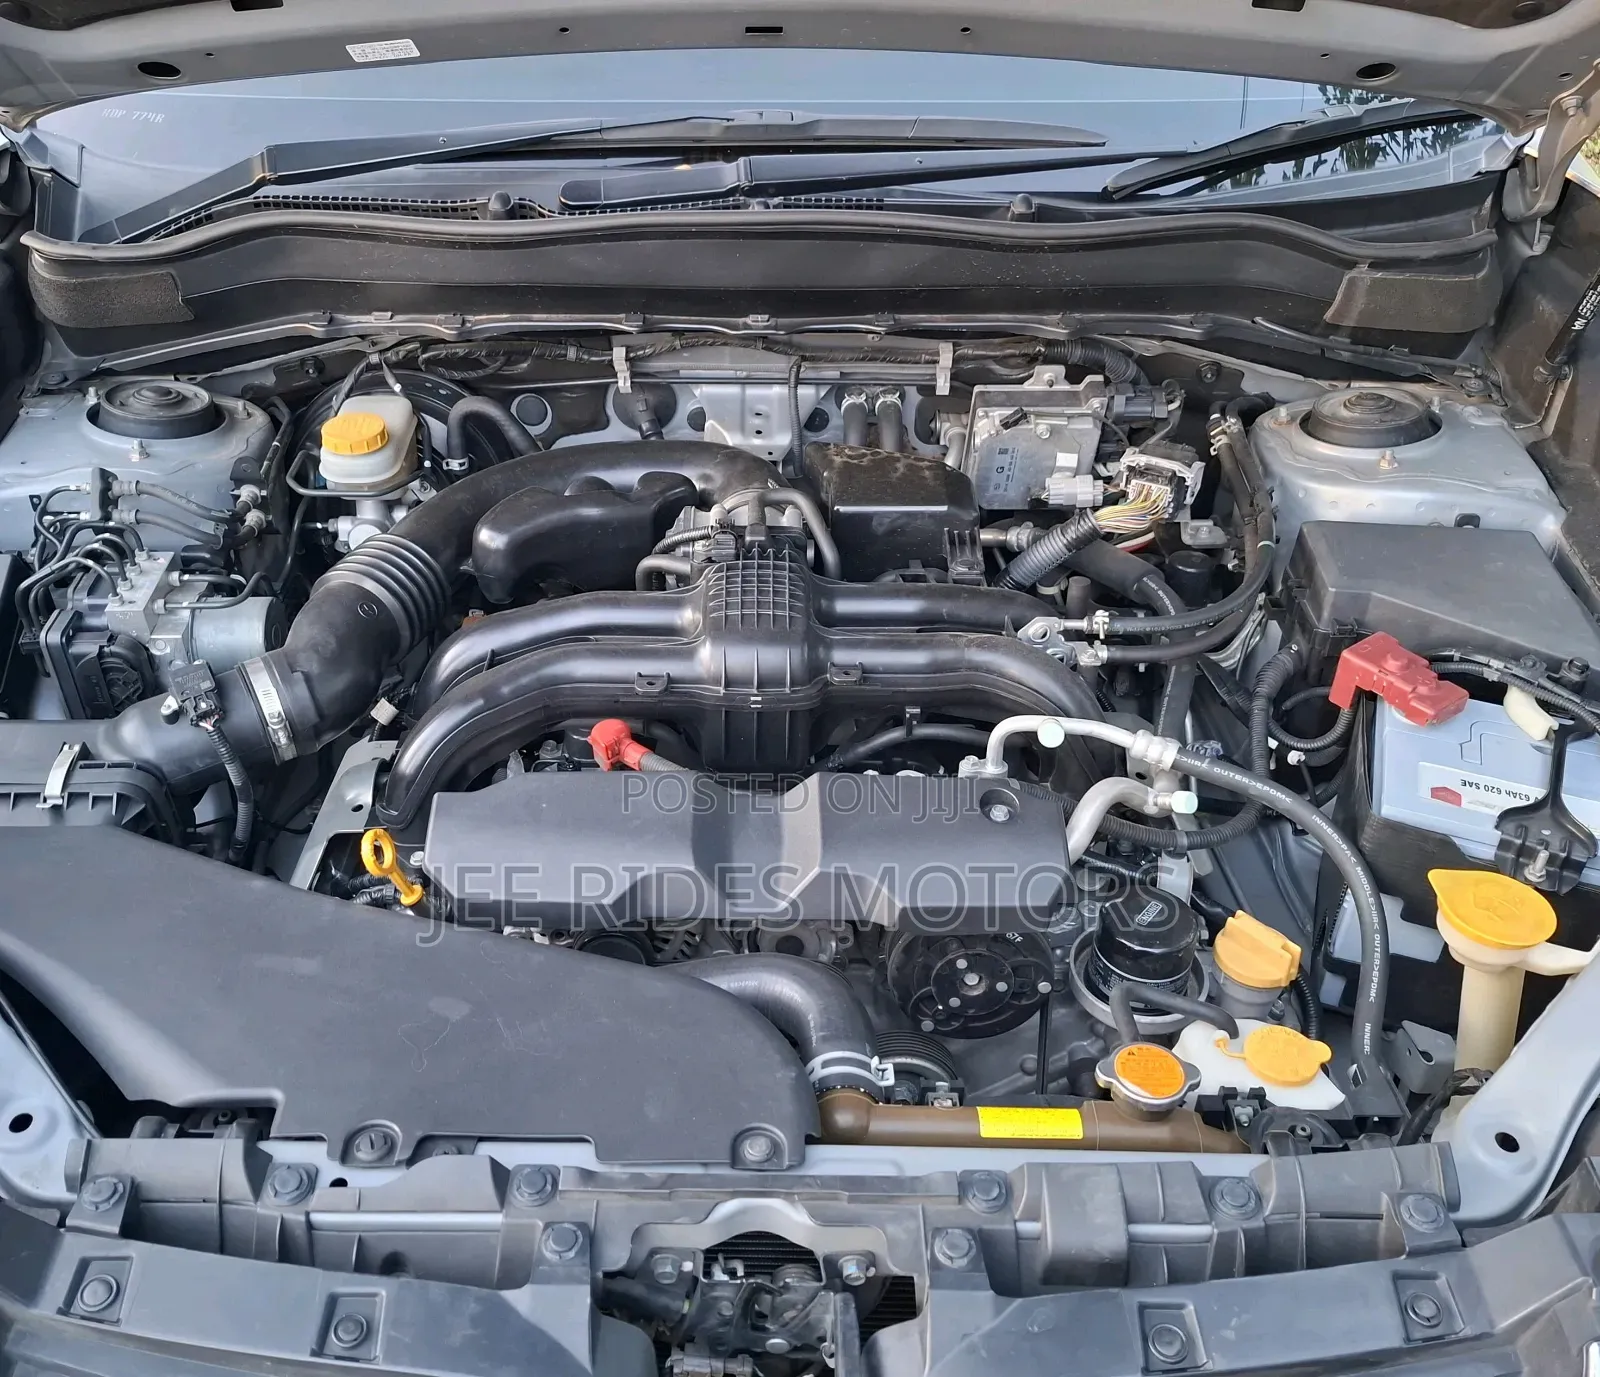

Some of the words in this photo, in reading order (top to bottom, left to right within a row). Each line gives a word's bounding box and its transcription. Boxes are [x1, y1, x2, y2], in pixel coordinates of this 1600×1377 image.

[1460, 779, 1481, 790] SAE
[1483, 784, 1502, 795] 620
[1505, 788, 1531, 802] 63Ah
[1138, 902, 1160, 924] ENGINE
